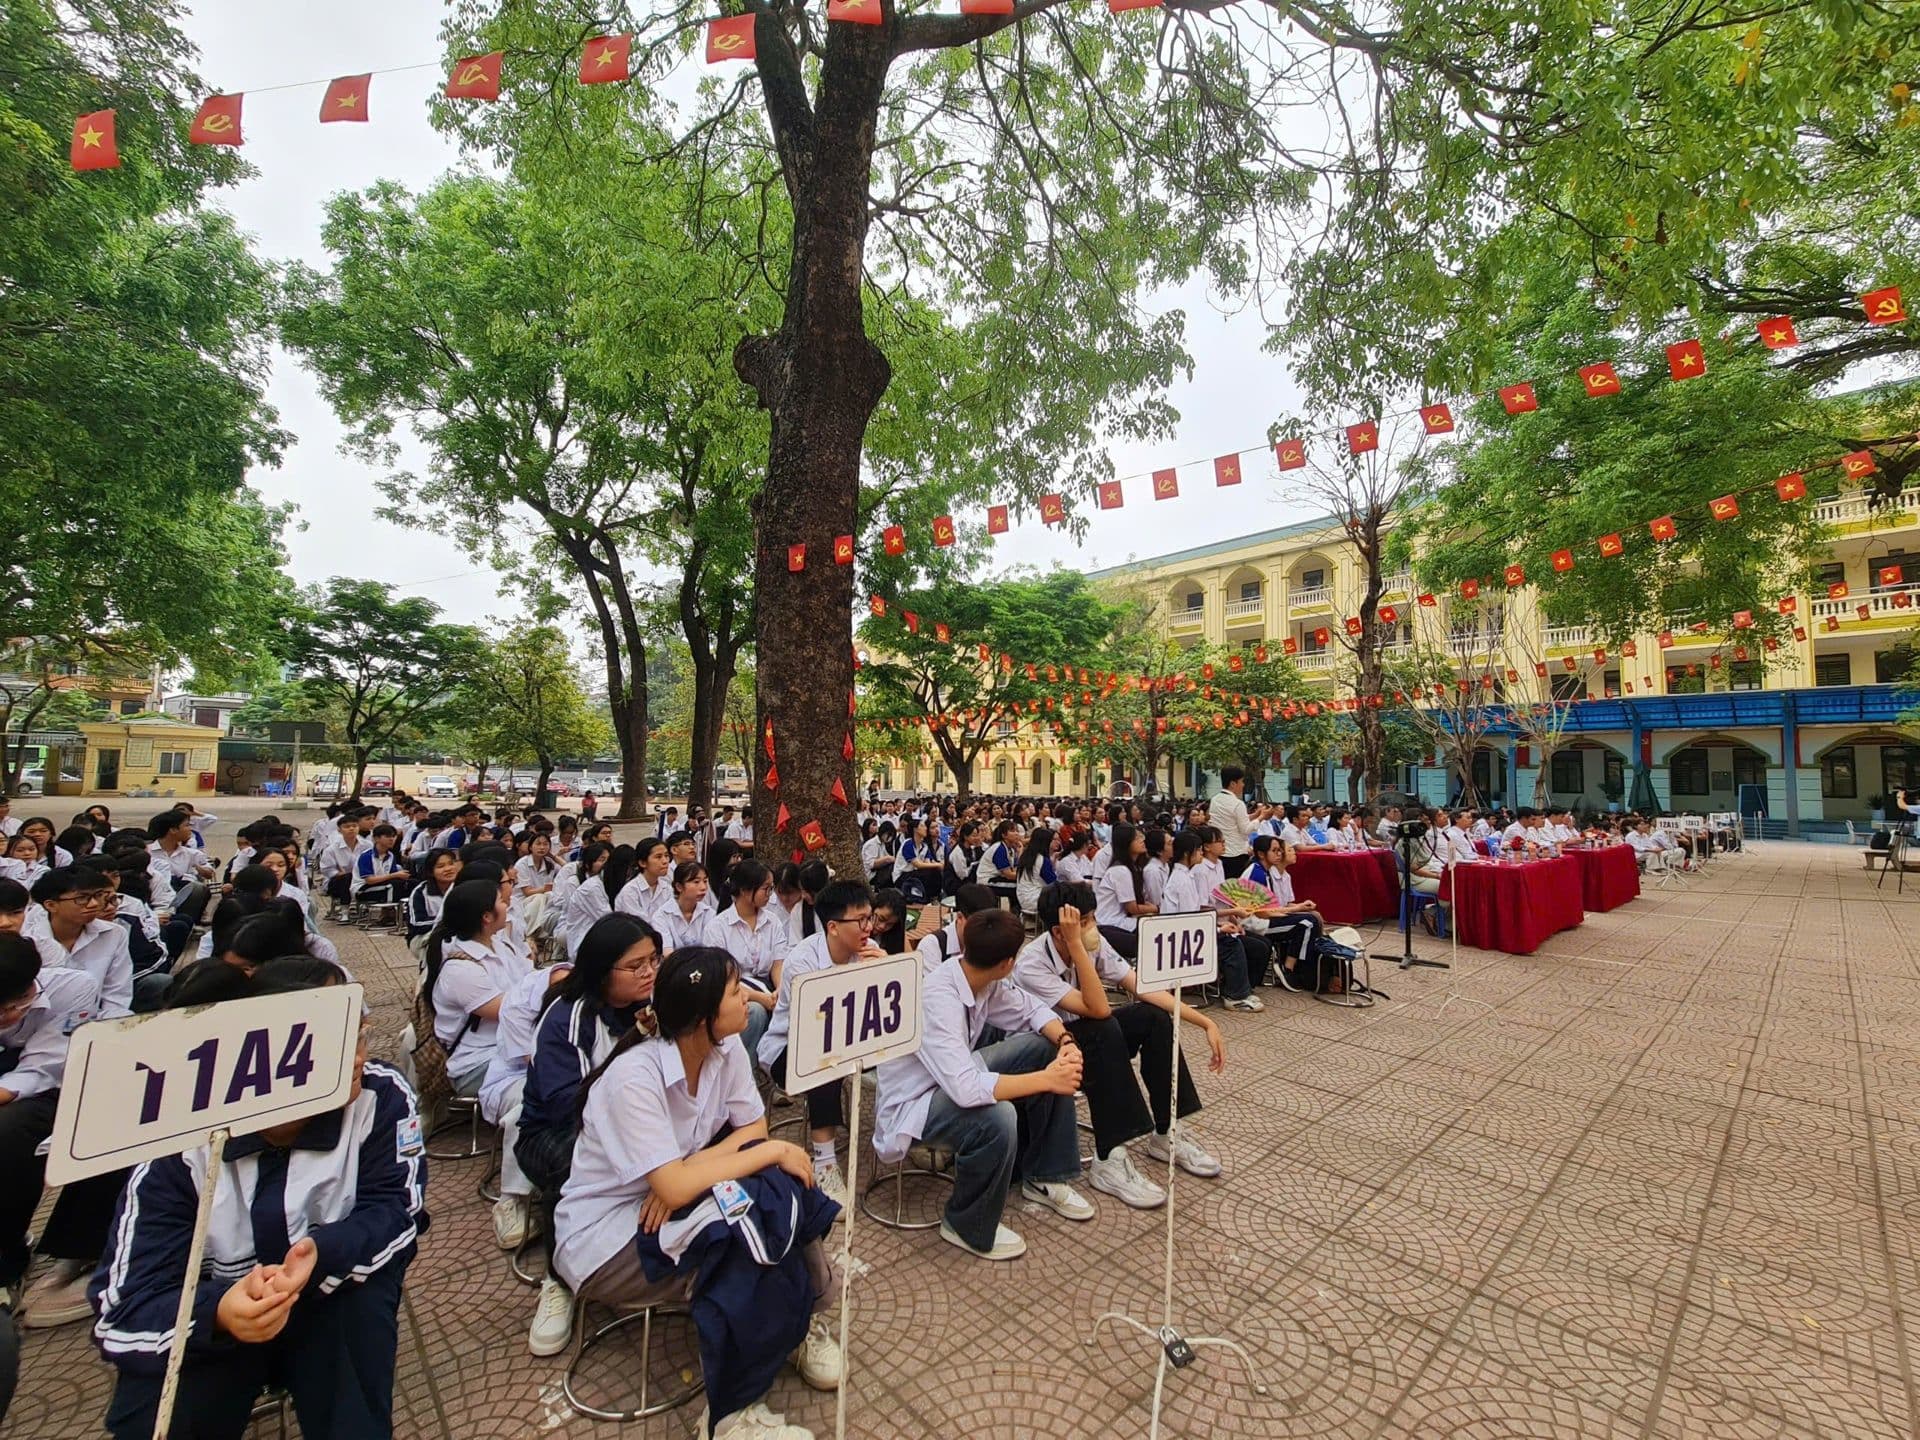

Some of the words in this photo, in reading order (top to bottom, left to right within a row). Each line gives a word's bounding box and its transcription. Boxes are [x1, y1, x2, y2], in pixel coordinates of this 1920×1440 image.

[1154, 928, 1205, 971] 11A2
[818, 980, 902, 1054] 11A3
[135, 1022, 314, 1125] 11A4
